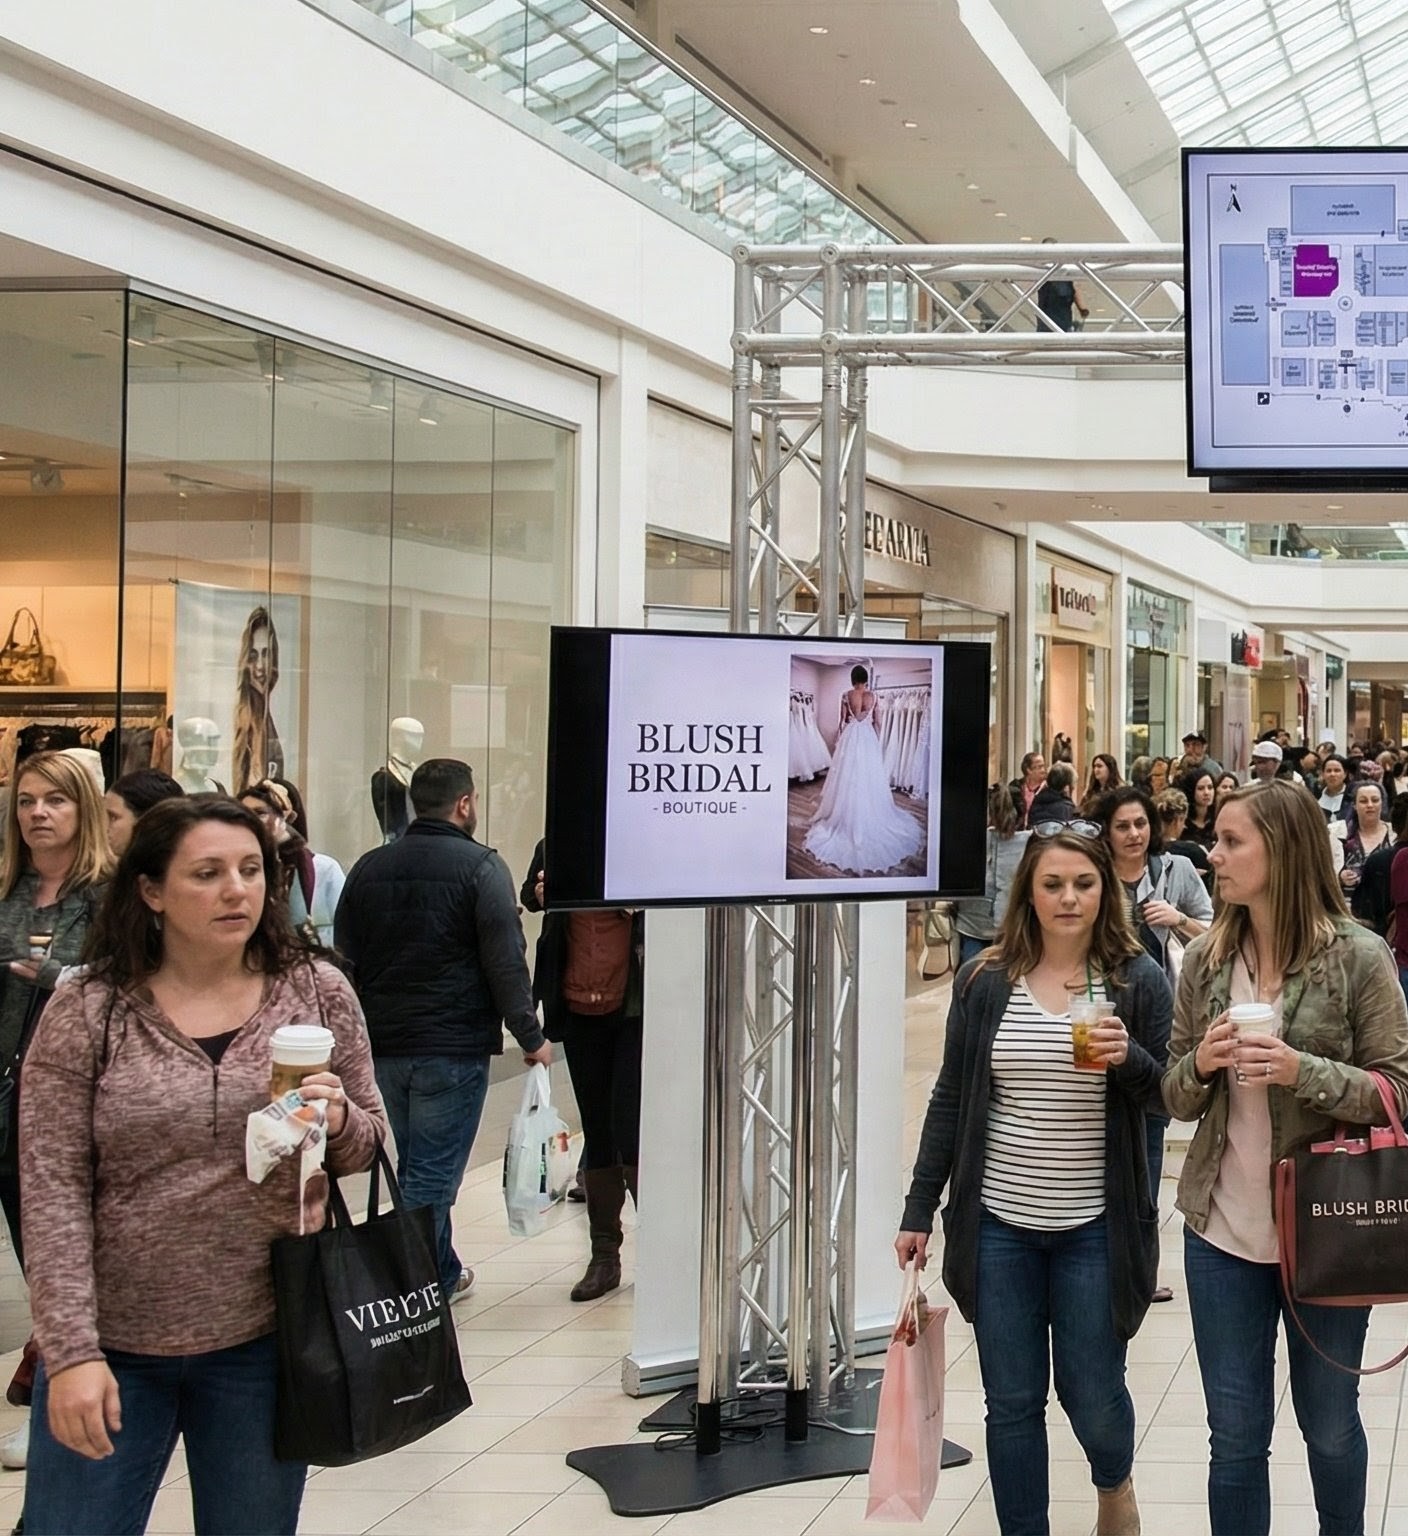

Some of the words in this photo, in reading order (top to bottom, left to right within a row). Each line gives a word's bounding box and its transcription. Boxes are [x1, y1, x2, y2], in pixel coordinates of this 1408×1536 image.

[637, 723, 764, 754] BLUSH
[627, 763, 771, 793] BRIDAL
[662, 801, 738, 814] BOUTIQUE
[1312, 1201, 1368, 1217] BLUSH
